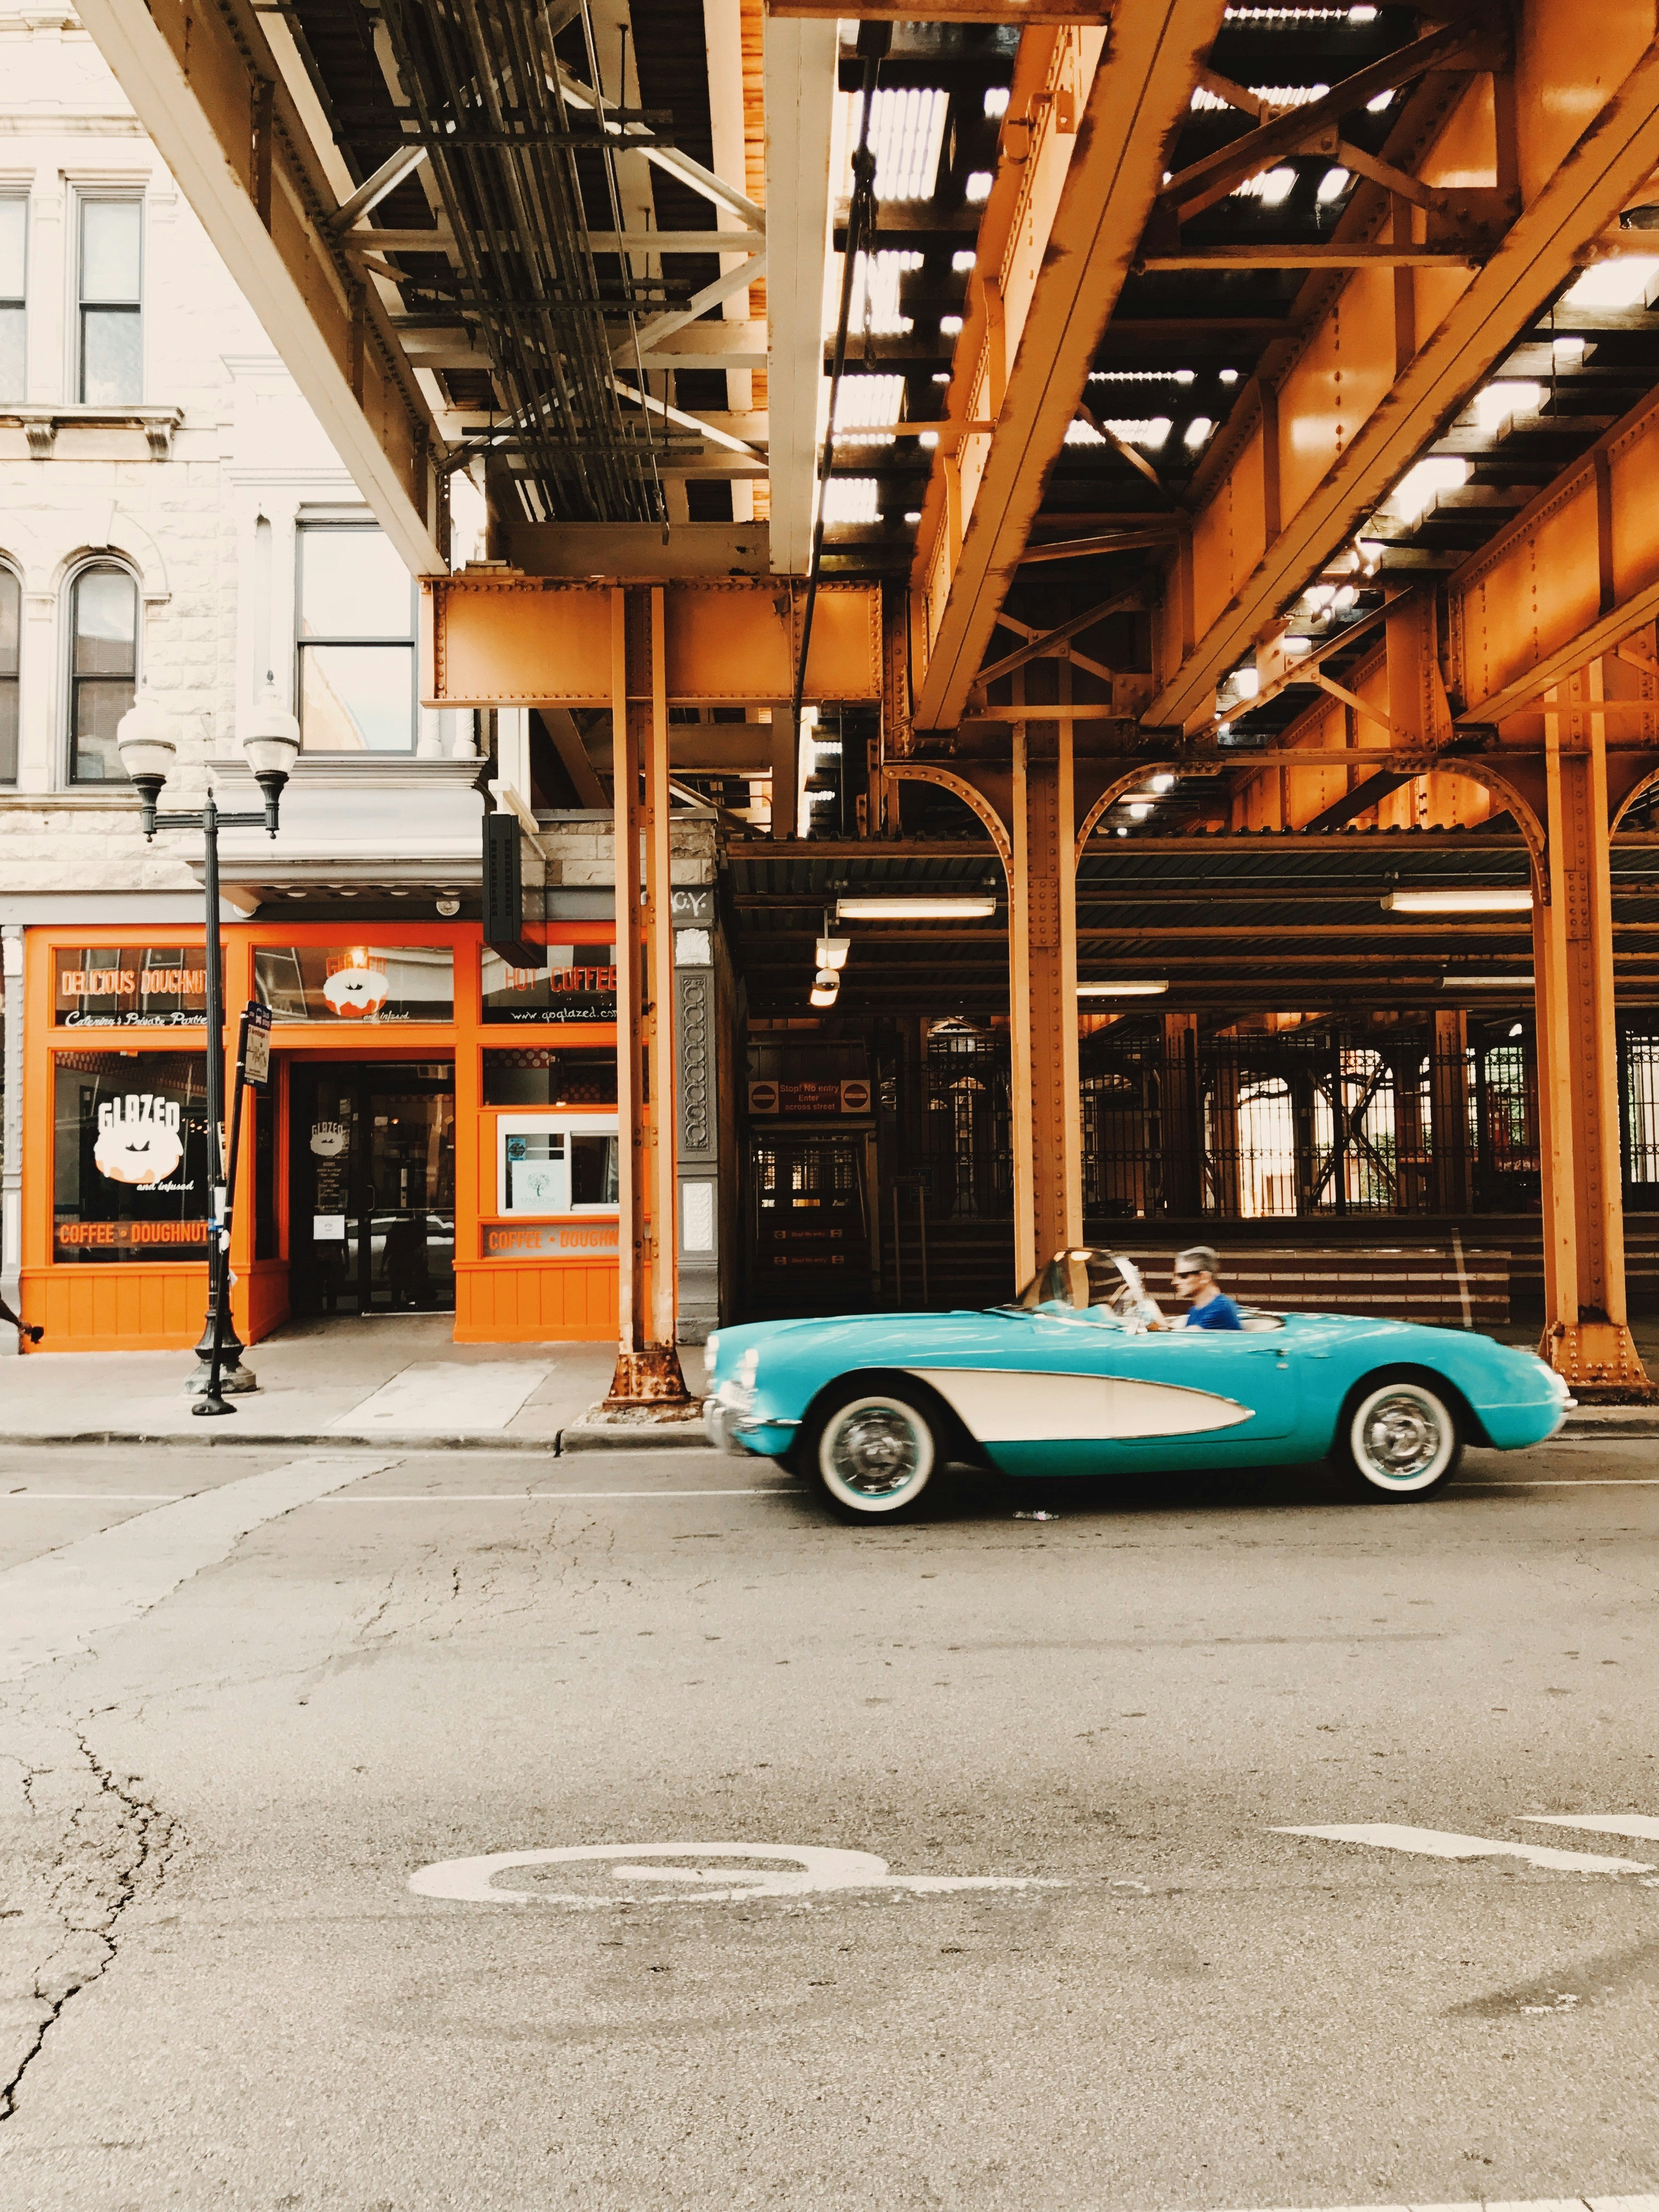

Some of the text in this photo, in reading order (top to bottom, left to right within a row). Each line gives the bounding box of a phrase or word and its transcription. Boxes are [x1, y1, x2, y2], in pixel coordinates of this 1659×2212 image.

[62, 970, 135, 995] DELICIOUS
[505, 966, 617, 992] HOT COFFEE
[65, 1011, 115, 1027] Catering
[123, 1012, 165, 1026] Private
[363, 1010, 410, 1022] and infused
[780, 1084, 802, 1094] Stop!
[818, 1085, 839, 1093] entry
[98, 1094, 180, 1133] GLAZED
[312, 1121, 343, 1135] GLAZED
[137, 1180, 194, 1193] and infused
[59, 1224, 115, 1243] COFFEE
[488, 1231, 542, 1250] COFFEE
